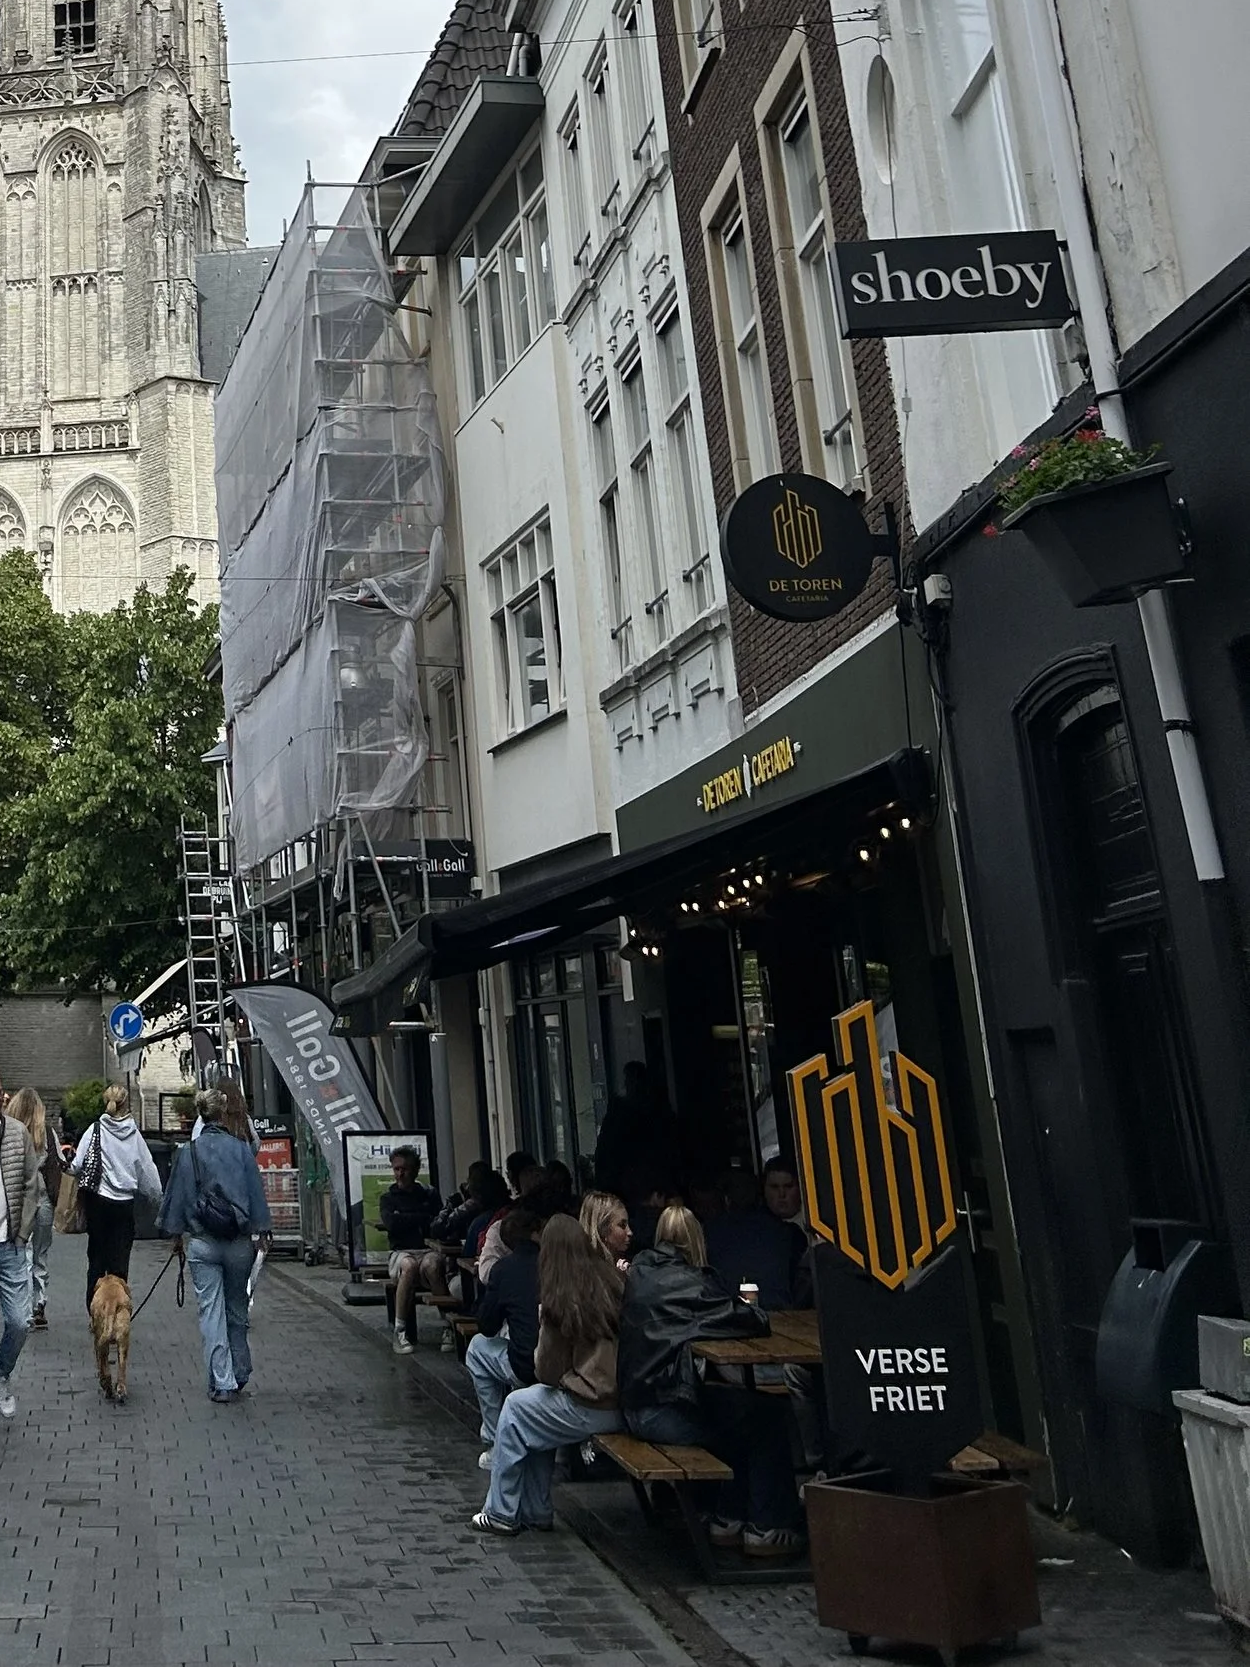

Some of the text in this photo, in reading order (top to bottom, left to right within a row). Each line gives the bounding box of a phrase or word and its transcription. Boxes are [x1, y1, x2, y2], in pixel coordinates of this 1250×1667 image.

[850, 245, 1052, 309] shoeby
[769, 578, 843, 592] DE TOREN
[713, 765, 743, 806] TOREN
[751, 735, 795, 787] CAFETARIA
[855, 1347, 949, 1375] VERSE
[869, 1385, 947, 1412] FRIET
